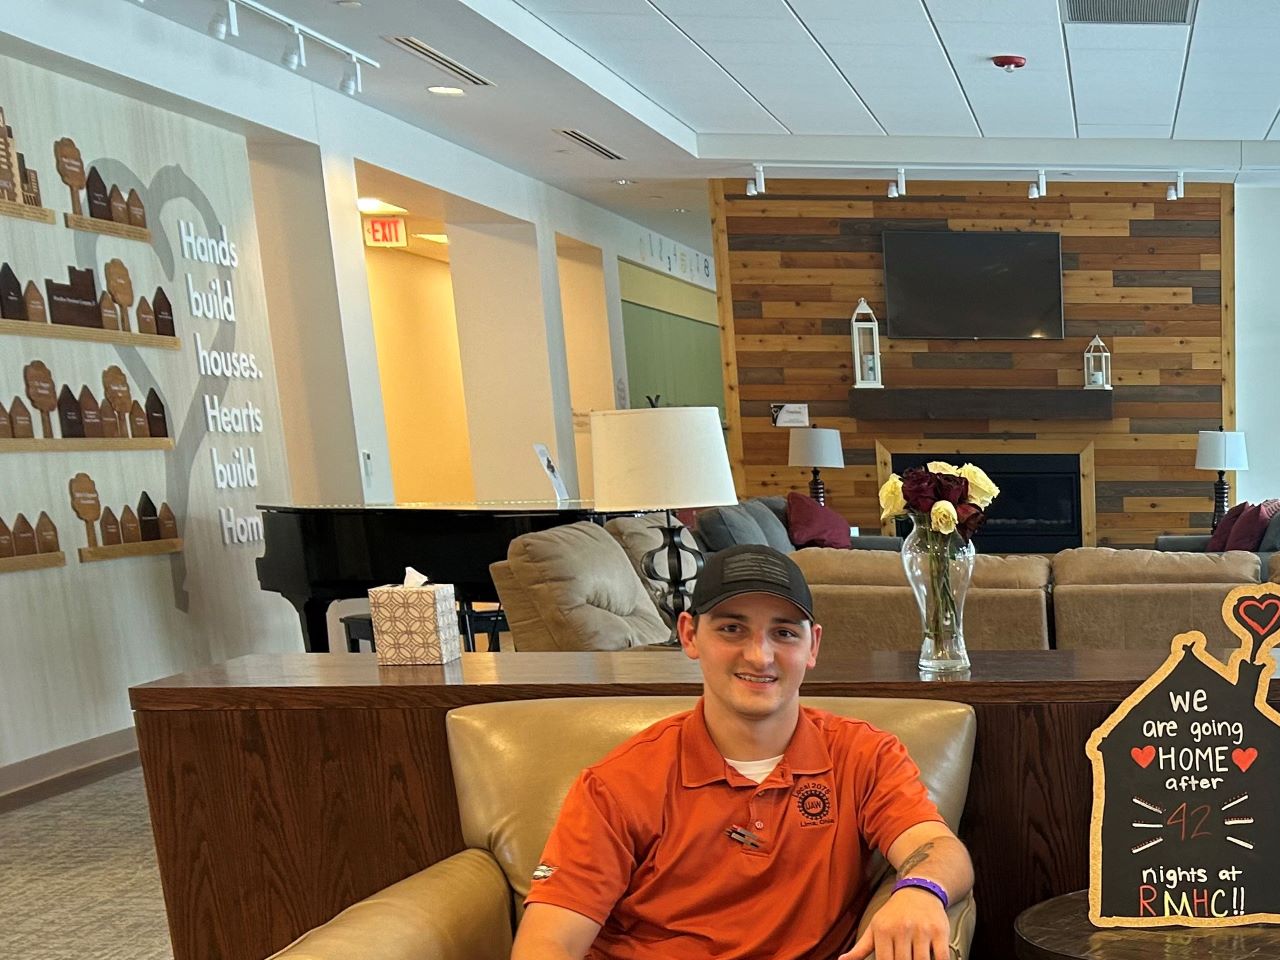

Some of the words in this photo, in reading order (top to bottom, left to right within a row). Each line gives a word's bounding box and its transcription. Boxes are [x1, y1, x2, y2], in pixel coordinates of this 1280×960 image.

[178, 219, 239, 268] Hands
[371, 219, 399, 242] EXIT
[186, 272, 236, 321] build
[194, 332, 263, 379] houses.
[204, 394, 263, 433] Hearts
[211, 447, 258, 489] build
[219, 506, 264, 544] Hom
[1169, 689, 1208, 713] we
[1142, 720, 1178, 738] are
[1190, 719, 1244, 745] going
[1158, 746, 1229, 772] HOME
[1165, 774, 1224, 791] after
[1166, 802, 1213, 840] 42
[1142, 865, 1208, 889] nights
[1218, 865, 1243, 882] at
